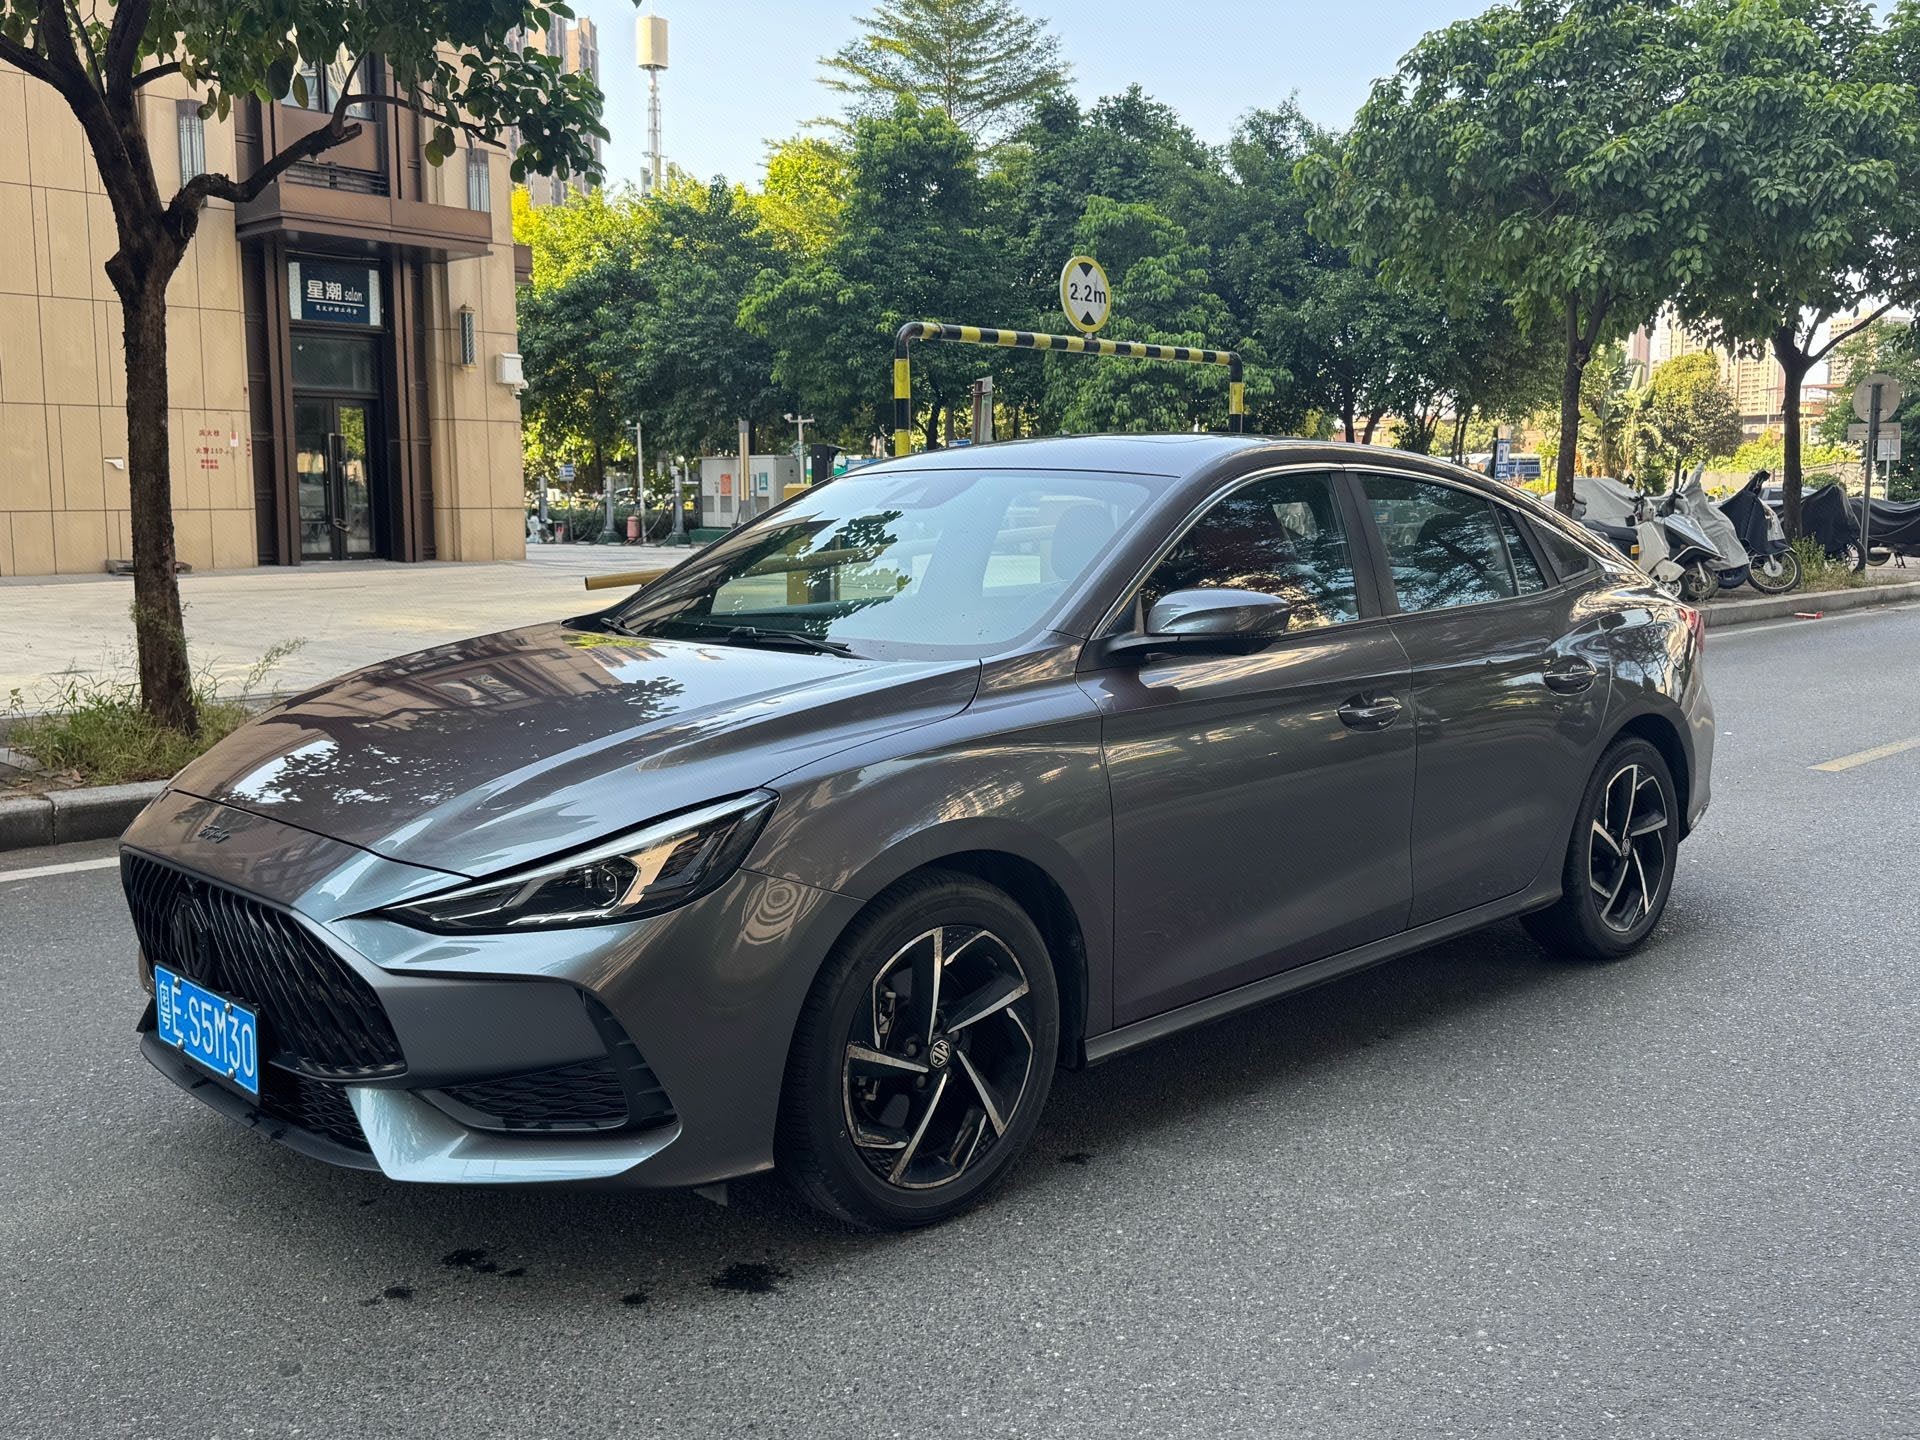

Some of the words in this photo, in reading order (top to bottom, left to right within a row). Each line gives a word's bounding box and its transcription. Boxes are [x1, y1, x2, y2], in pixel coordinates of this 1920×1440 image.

[307, 279, 342, 300] 星潮
[344, 286, 363, 302] salon
[1070, 282, 1106, 304] 2.2m
